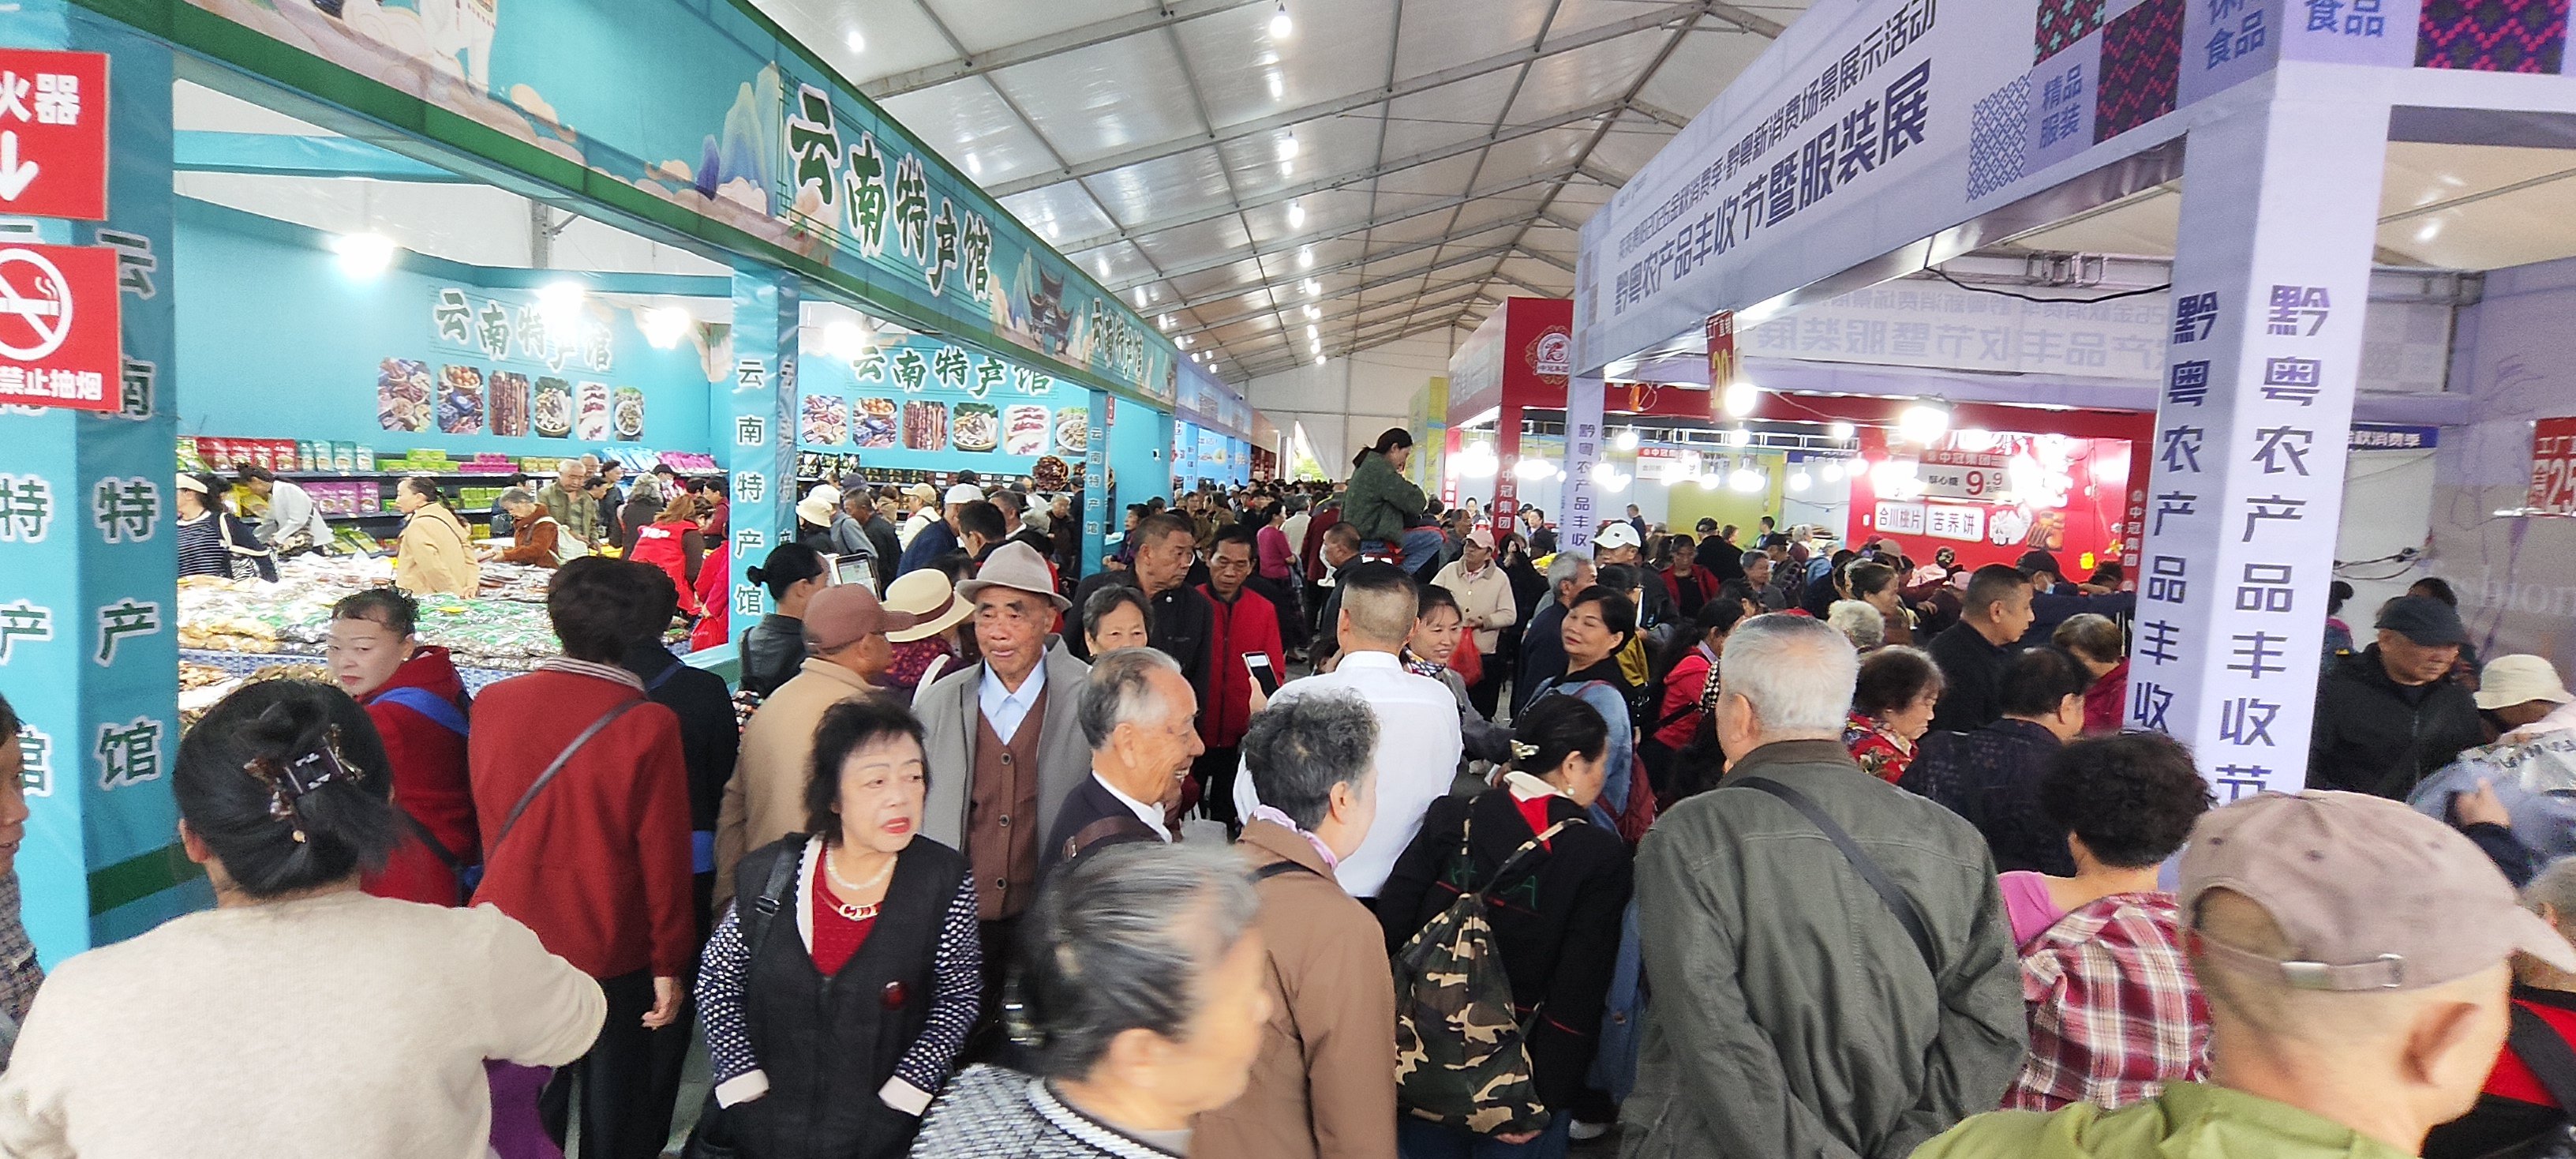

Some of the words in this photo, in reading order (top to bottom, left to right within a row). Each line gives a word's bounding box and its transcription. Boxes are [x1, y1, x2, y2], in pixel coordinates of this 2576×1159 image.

[2204, 9, 2266, 70] 食品
[2305, 0, 2385, 37] 食品
[2041, 62, 2084, 112] 精品
[2038, 103, 2081, 150] 服装
[788, 84, 991, 301] 云南特产馆
[1615, 58, 1932, 316] 黔粤农产品丰收节暨服装展
[0, 366, 103, 401] 禁止抽烟
[735, 358, 766, 614] 云南特产馆
[1497, 469, 1515, 530] 中冠集团
[1933, 512, 1975, 535] 苦荞饼
